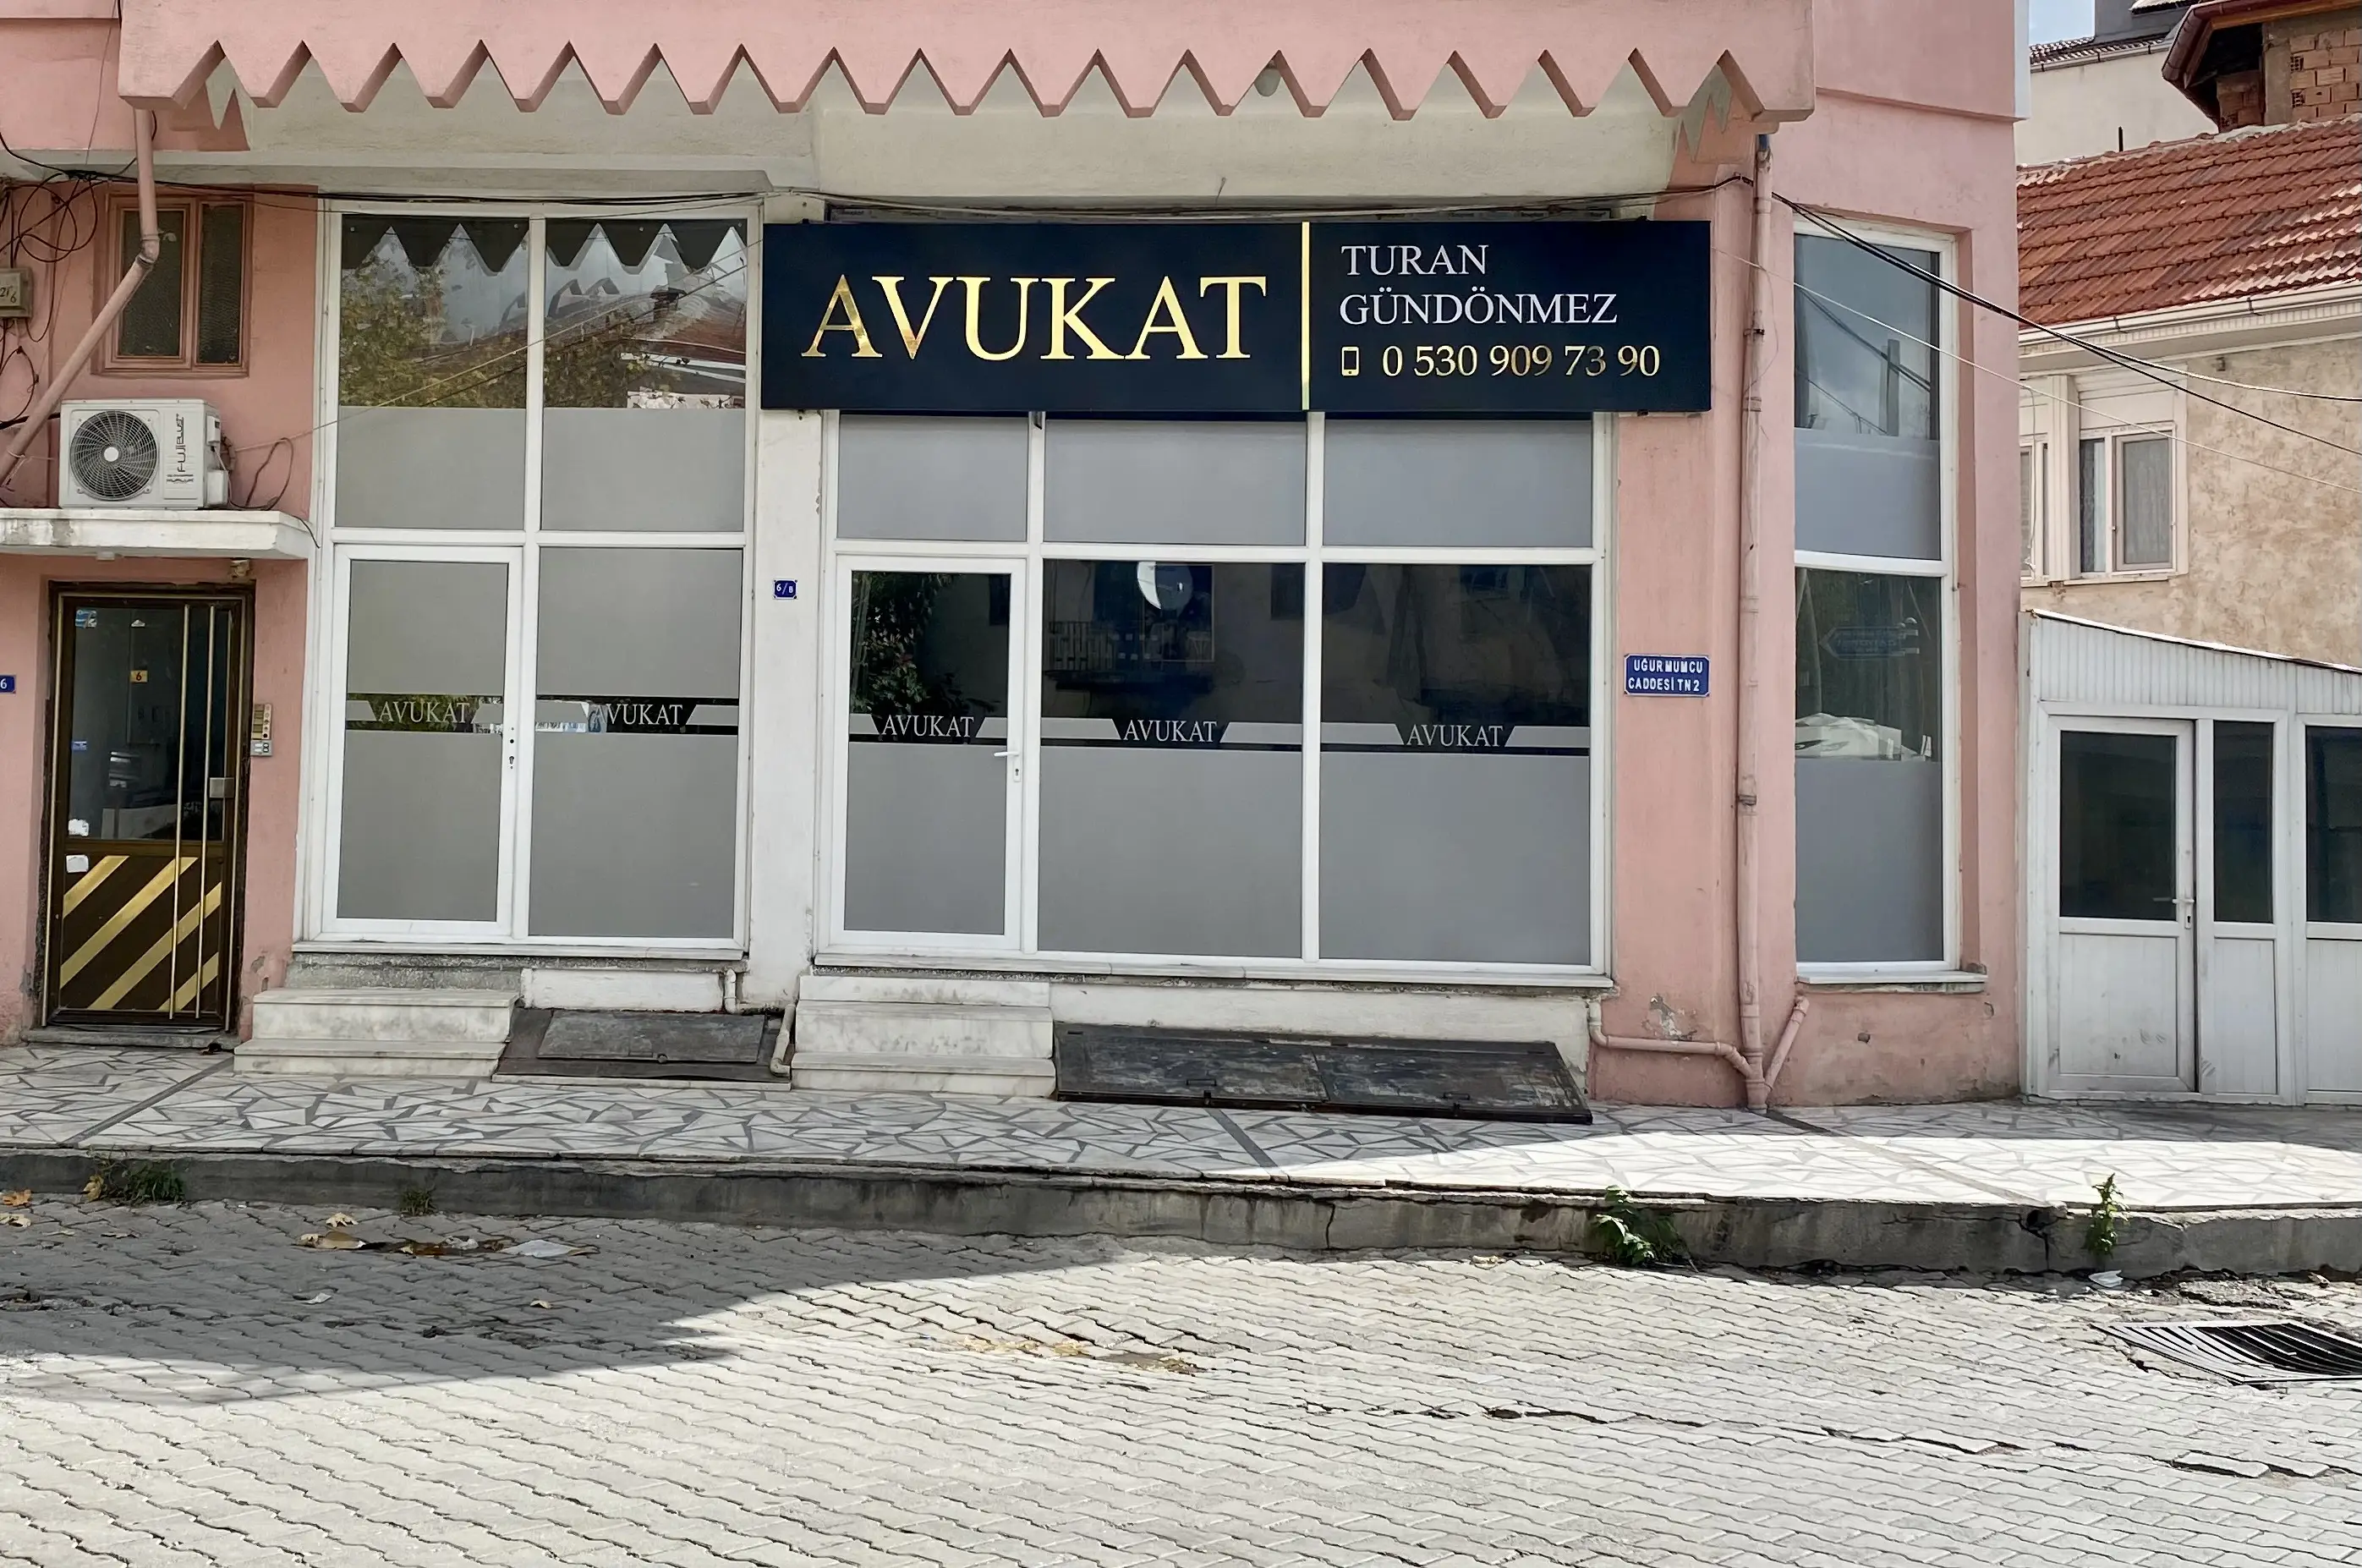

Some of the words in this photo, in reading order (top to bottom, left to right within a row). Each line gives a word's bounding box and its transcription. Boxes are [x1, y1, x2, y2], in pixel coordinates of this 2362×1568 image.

[1340, 244, 1489, 276] TURAN
[801, 273, 1267, 361] AVUKAT
[1339, 285, 1618, 326] GÜNDÖNMEZ
[1382, 345, 1404, 376] 0
[1413, 345, 1477, 376] 530
[1489, 345, 1553, 376] 909
[1565, 345, 1607, 376] 73
[1617, 345, 1660, 376] 90
[378, 701, 470, 723] AVUKAT
[593, 703, 683, 726] AVUKAT
[881, 714, 974, 737] AVUKAT
[1123, 719, 1218, 743] AVUKAT
[1406, 723, 1504, 747] AVUKAT
